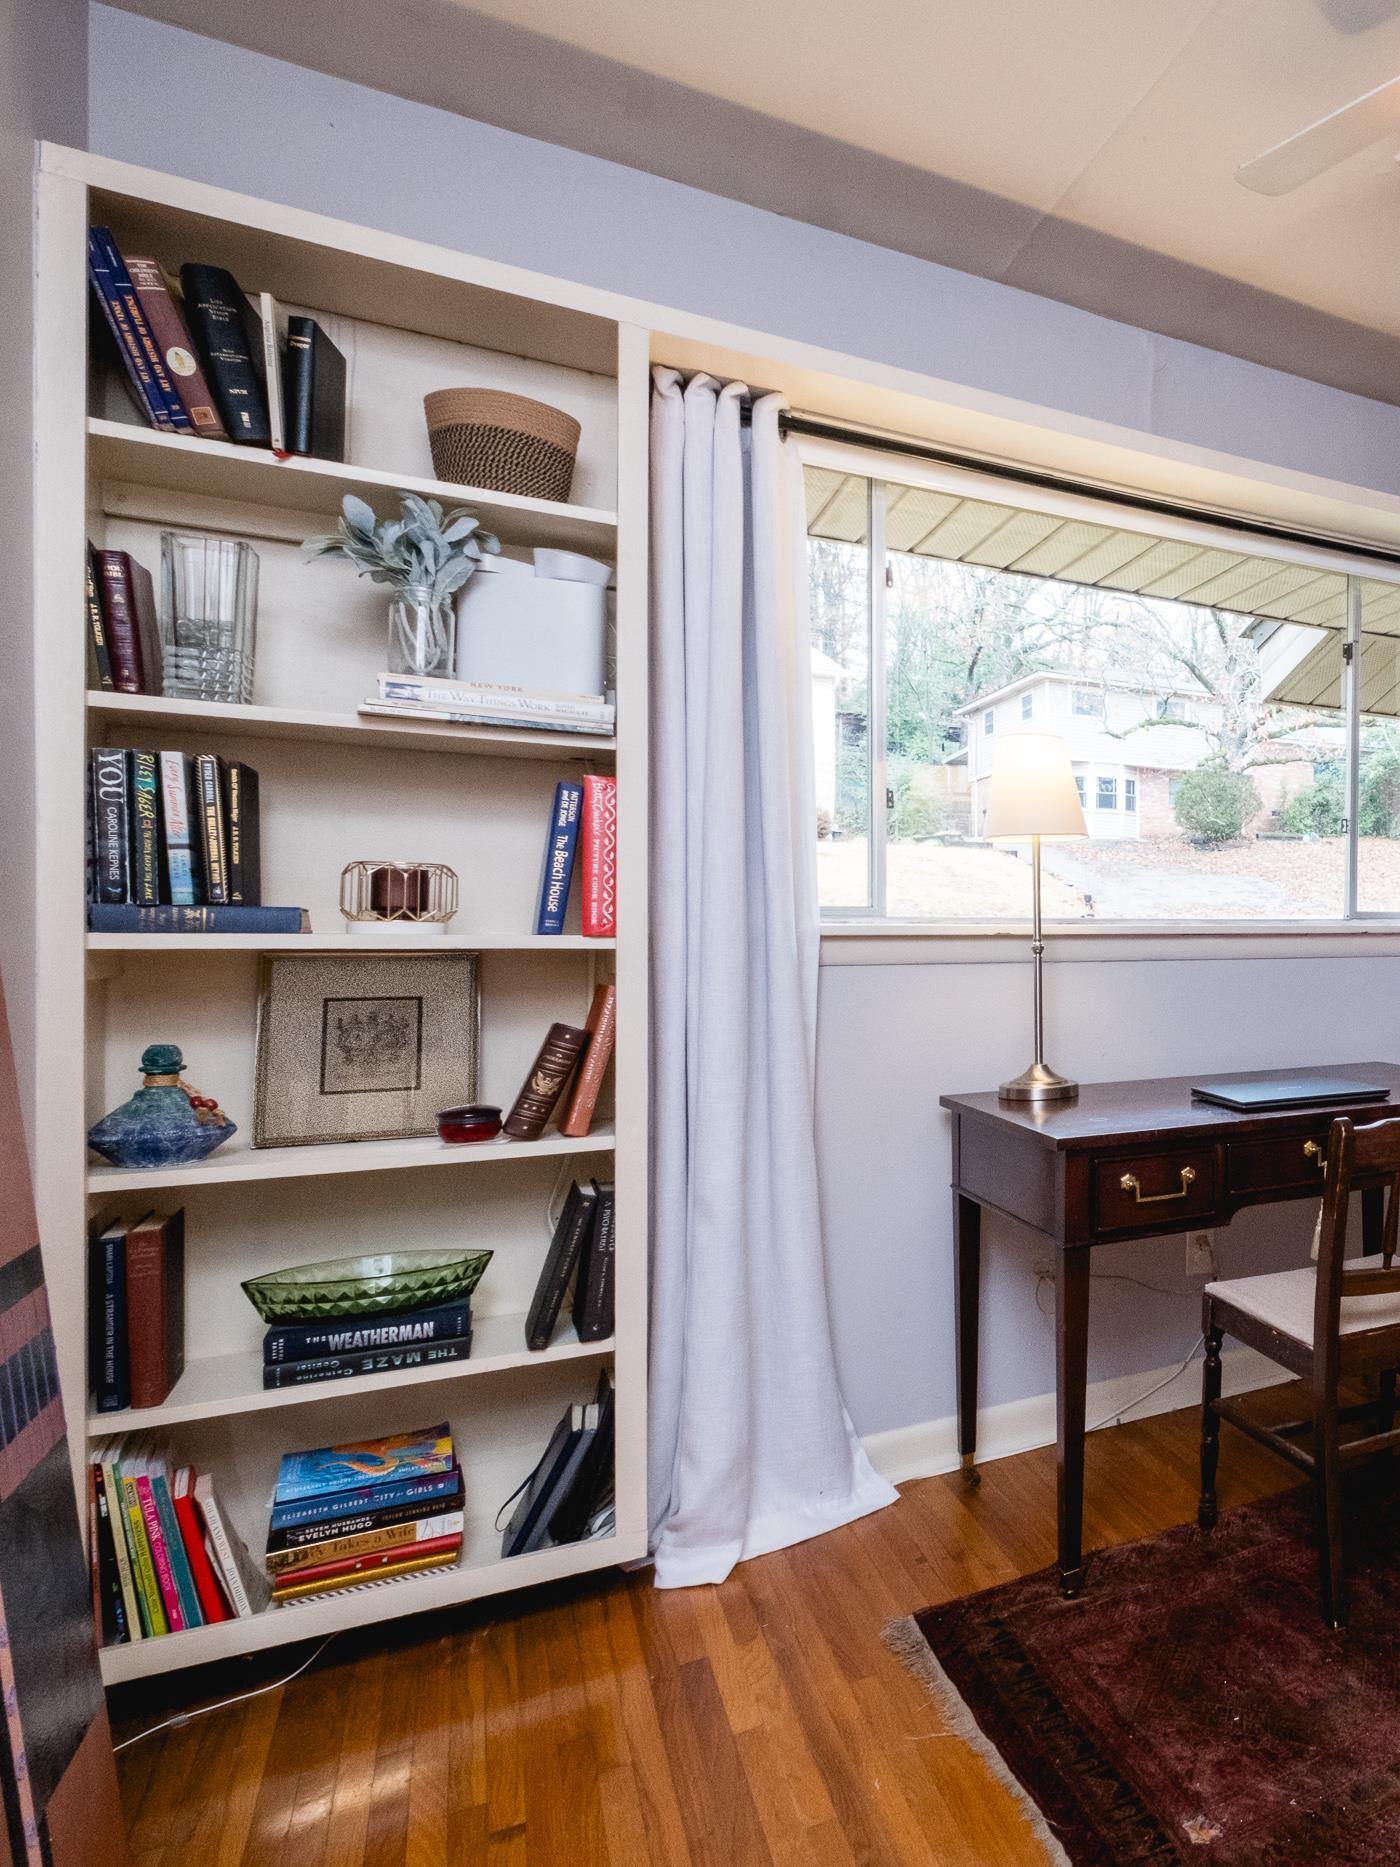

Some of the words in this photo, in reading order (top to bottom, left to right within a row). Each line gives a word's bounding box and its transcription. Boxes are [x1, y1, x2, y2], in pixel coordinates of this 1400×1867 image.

[98, 752, 124, 804] YOU
[136, 753, 156, 783] RILEY
[137, 785, 156, 818] SAGER
[105, 806, 119, 848] CAROLINE
[556, 835, 568, 849] The
[108, 849, 120, 880] KEPNES
[551, 850, 569, 880] Beach
[547, 881, 565, 912] House
[306, 1336, 327, 1344] THE
[328, 1321, 434, 1351] WEATHERMAN
[361, 1351, 422, 1370] MAZE
[428, 1347, 458, 1360] THE
[142, 1498, 156, 1520] TULA
[282, 1507, 328, 1520] ELIZABETH
[406, 1484, 433, 1496] GIRLS
[148, 1520, 161, 1541] PINK
[299, 1528, 339, 1541] EVELYN
[342, 1520, 373, 1532] HUGO
